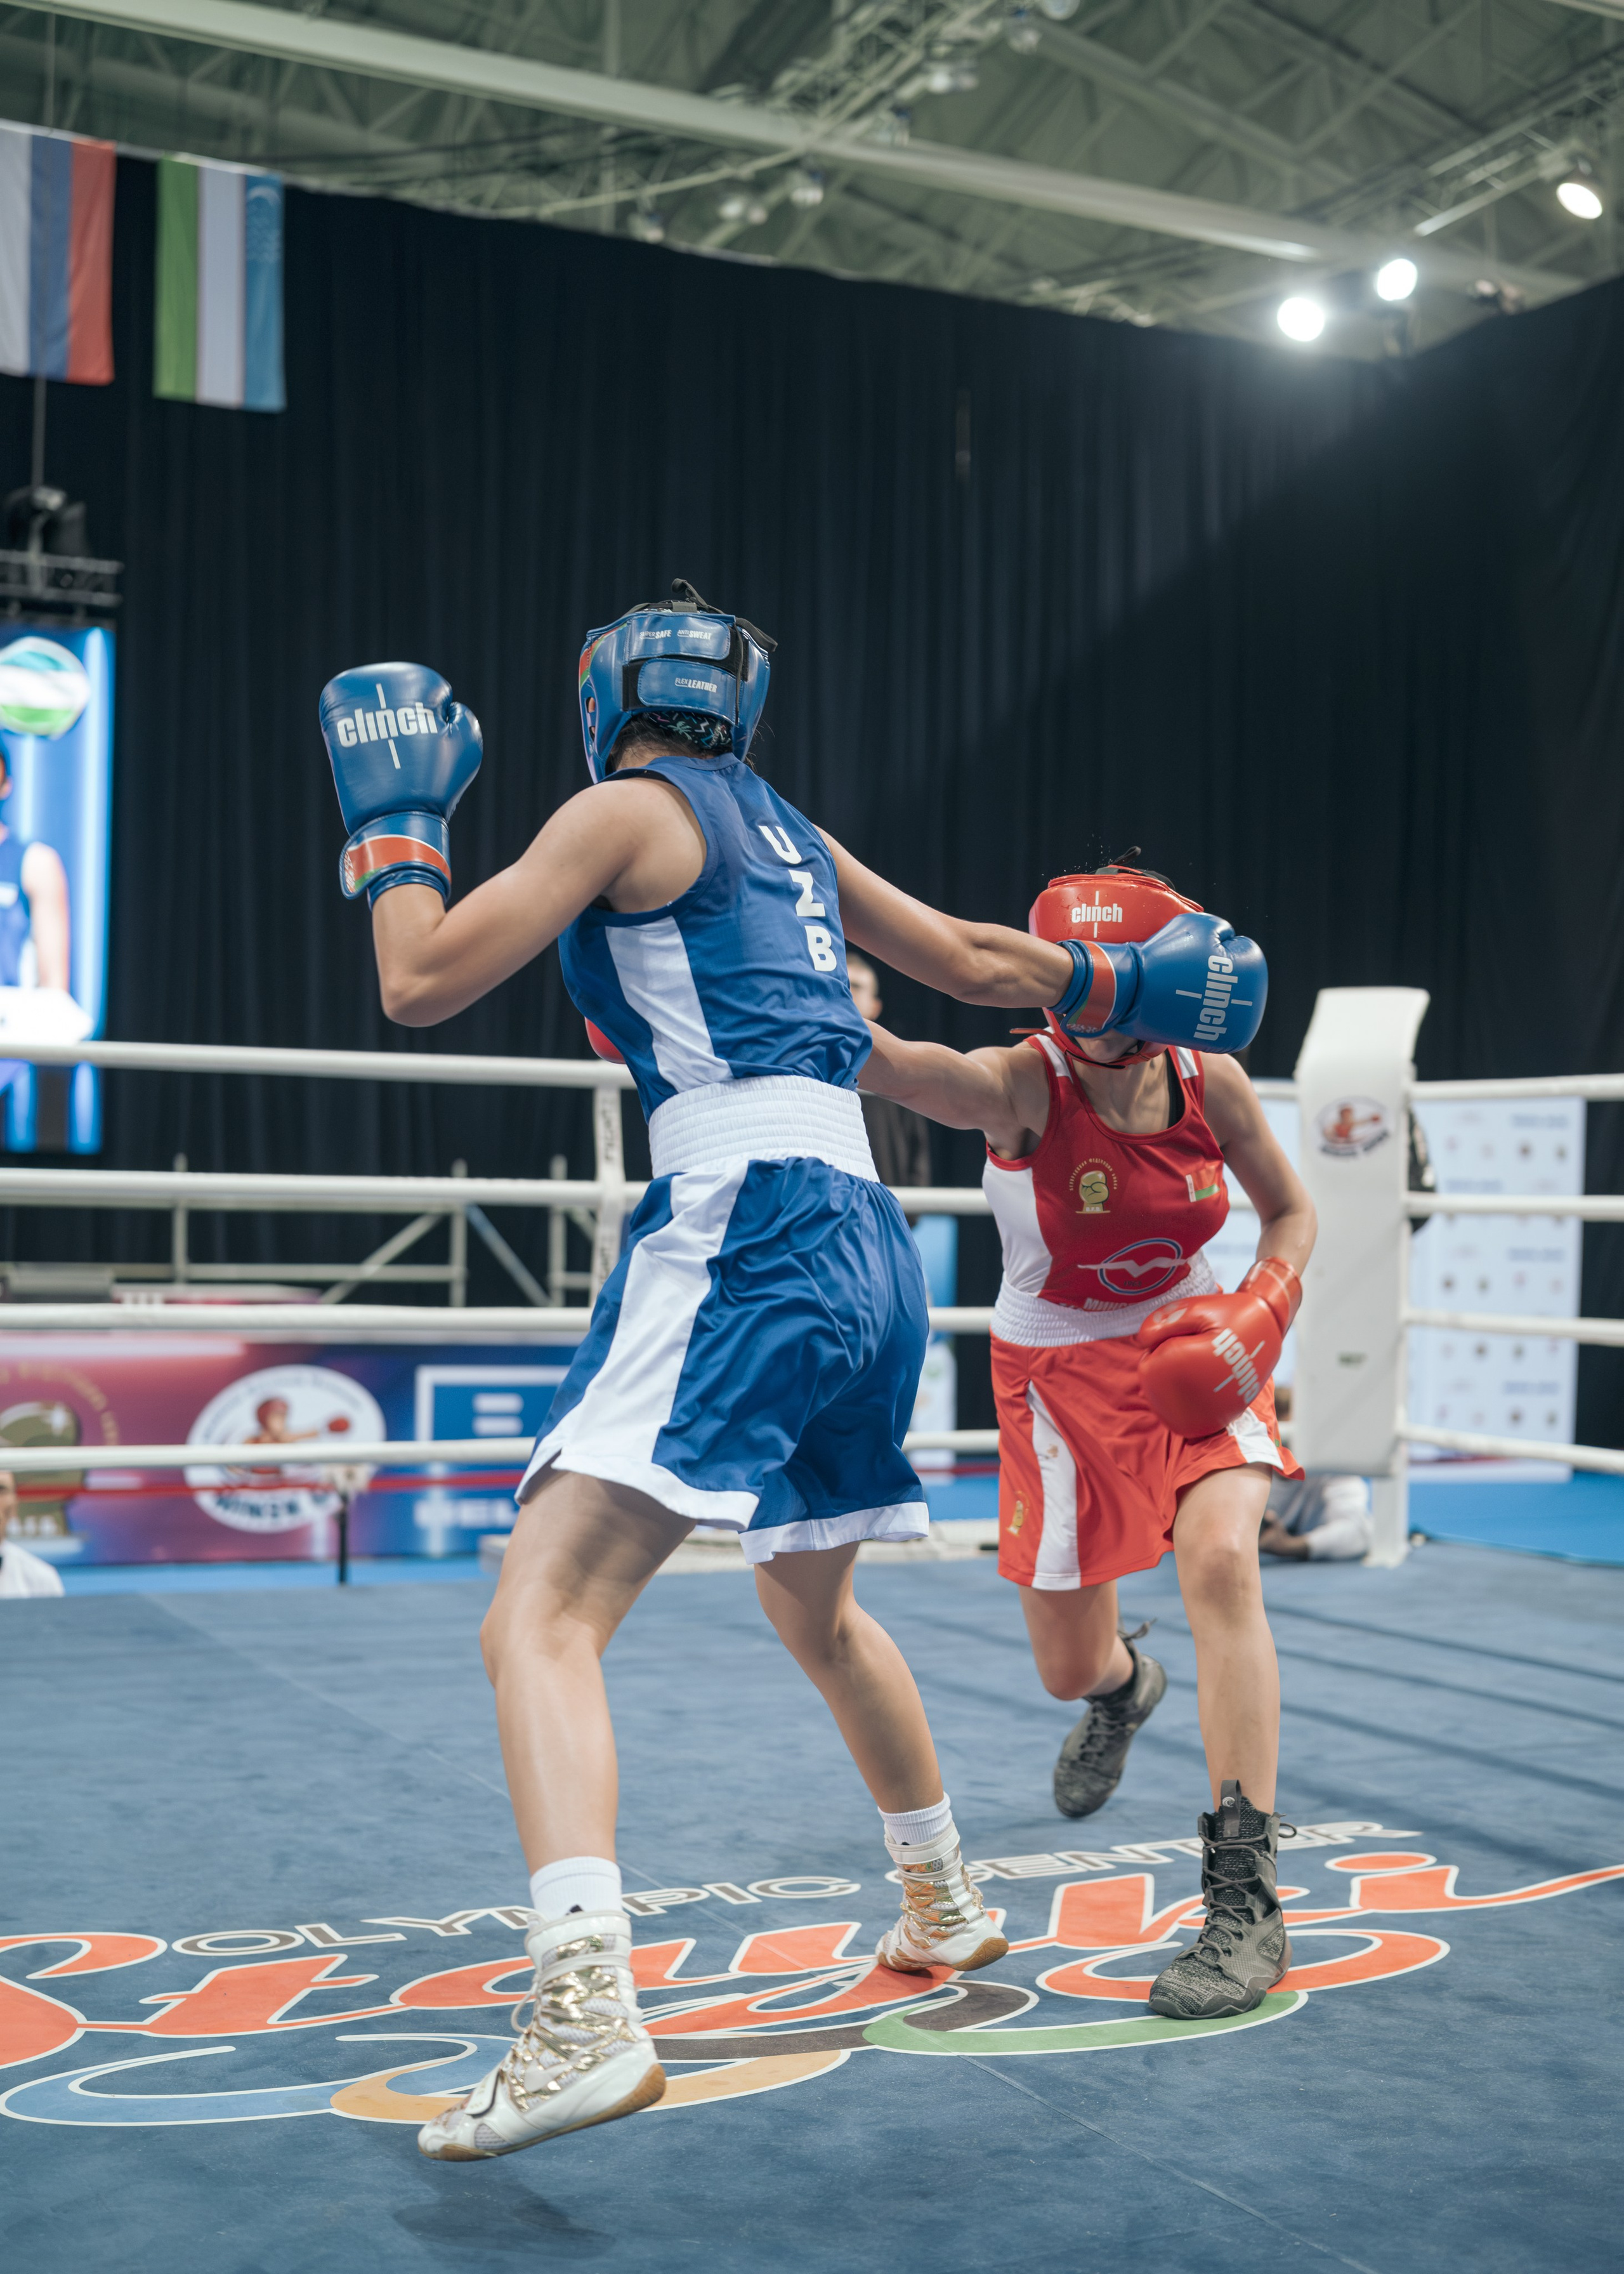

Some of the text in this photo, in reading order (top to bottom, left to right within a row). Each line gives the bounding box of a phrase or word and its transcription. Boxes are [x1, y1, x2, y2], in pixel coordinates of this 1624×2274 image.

[655, 629, 672, 639] SAFE
[689, 630, 712, 640] SWEAT
[688, 679, 717, 693] LEATHER
[337, 702, 438, 747] clinch
[758, 825, 837, 972] UZB
[1071, 903, 1123, 923] clinch
[1193, 955, 1238, 1041] clinch
[1212, 1328, 1261, 1404] clinch
